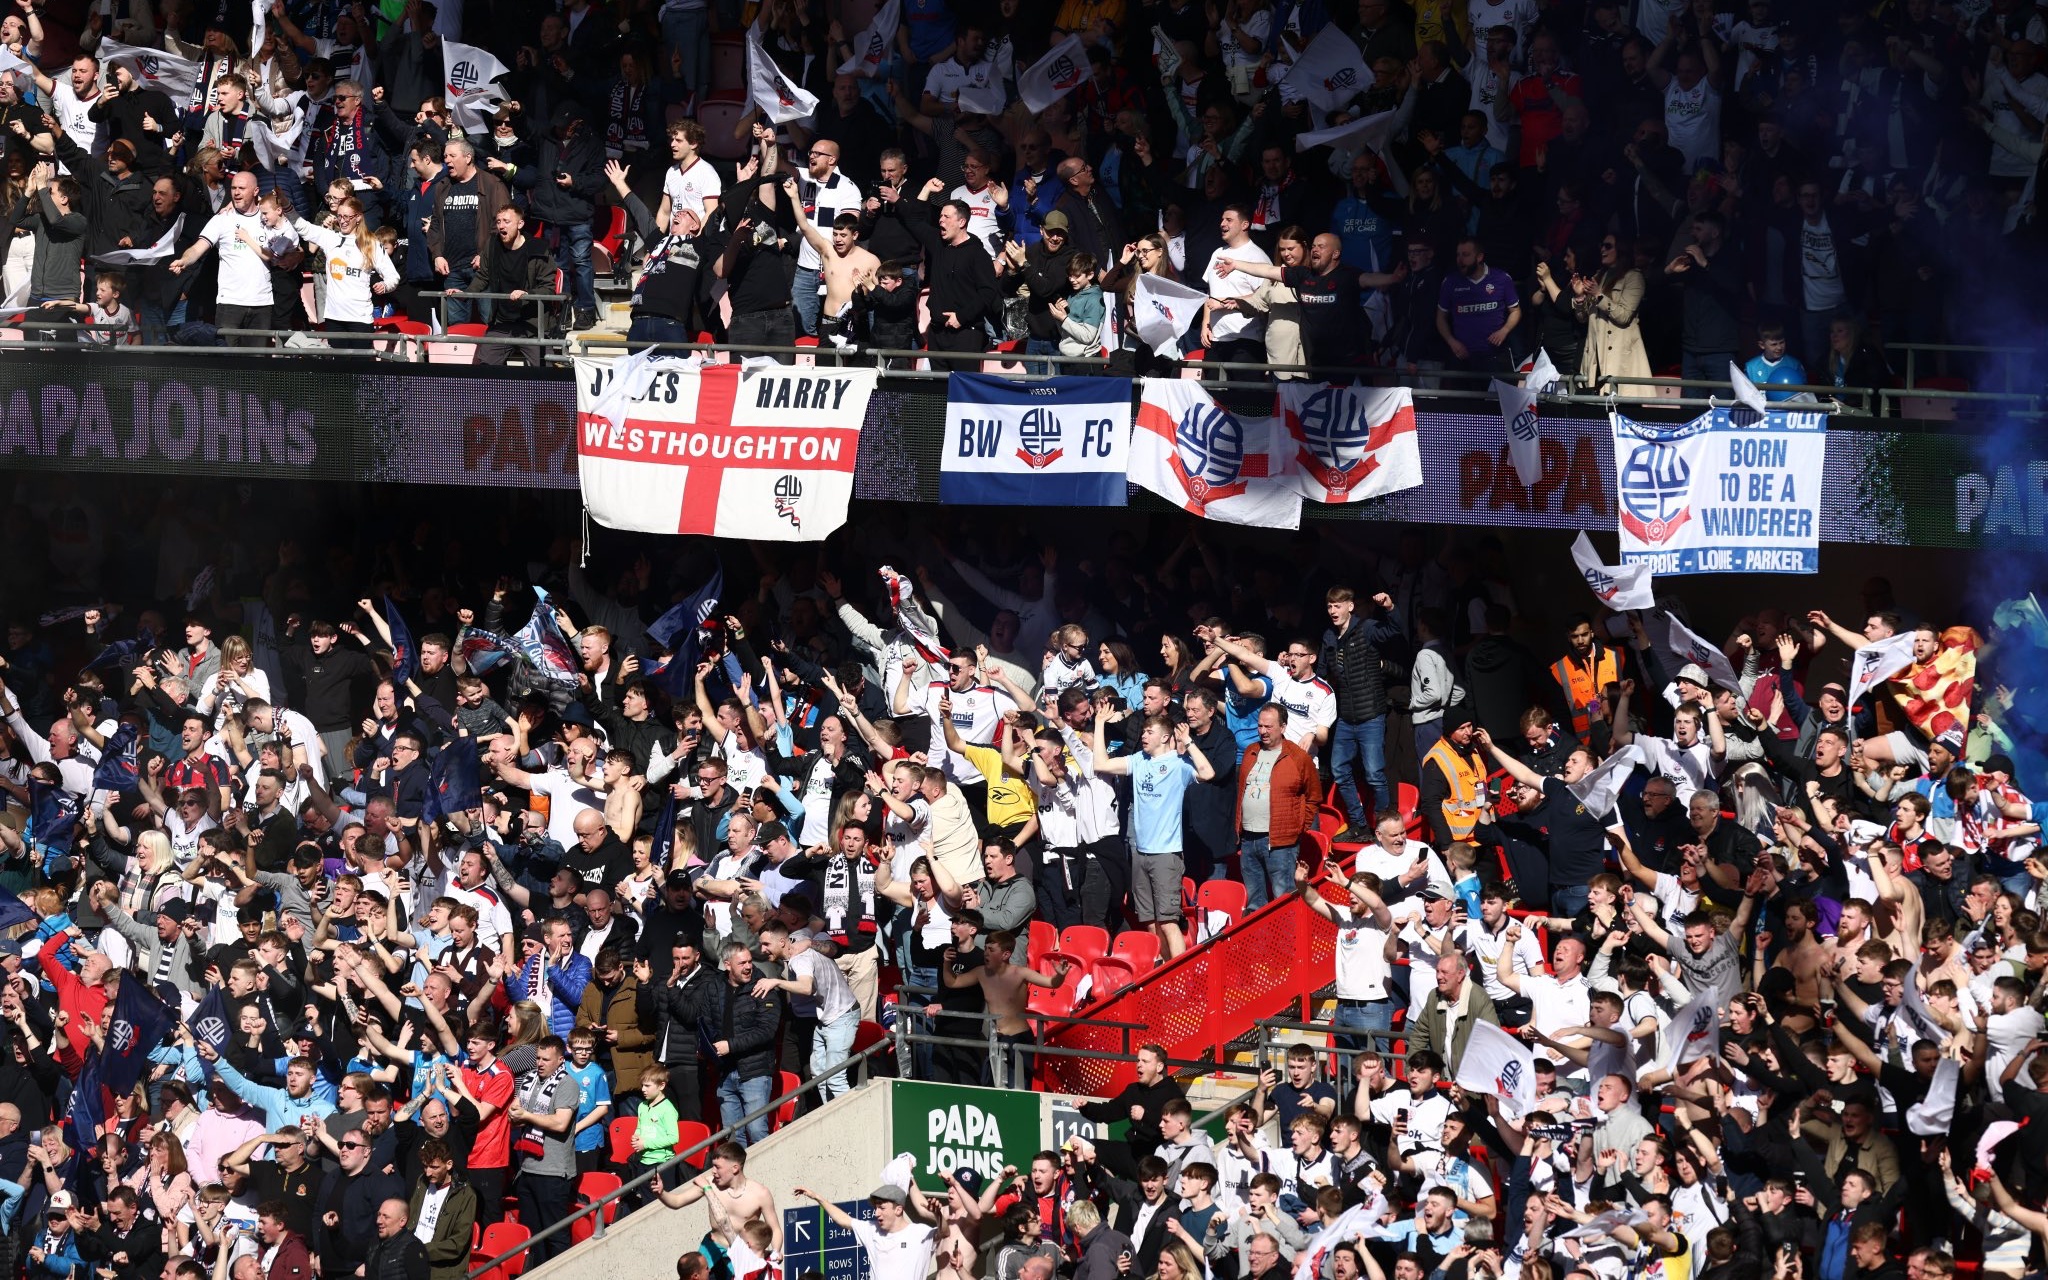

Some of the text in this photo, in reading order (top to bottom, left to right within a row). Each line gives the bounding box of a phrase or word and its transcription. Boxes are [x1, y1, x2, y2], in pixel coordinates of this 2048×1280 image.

[453, 195, 479, 206] BOLTON
[1457, 301, 1498, 313] BETFRED
[590, 367, 852, 410] JES HARRY
[0, 380, 119, 457] APA
[1786, 412, 1822, 430] OLLY
[584, 421, 842, 462] WESTHOUGHTON
[958, 418, 1113, 457] BW FC
[1729, 438, 1788, 467] BORN
[1719, 472, 1796, 503] TO BE A
[1701, 507, 1812, 538] WANDERER
[1745, 551, 1804, 571] PARKER
[952, 712, 974, 721] rmid
[1141, 783, 1154, 792] HB
[525, 1133, 545, 1144] BOLTON
[928, 1104, 1003, 1149] PAPA
[926, 1146, 1004, 1180] JOHNS
[828, 1229, 852, 1240] 31-44
[828, 1258, 853, 1270] ROWS
